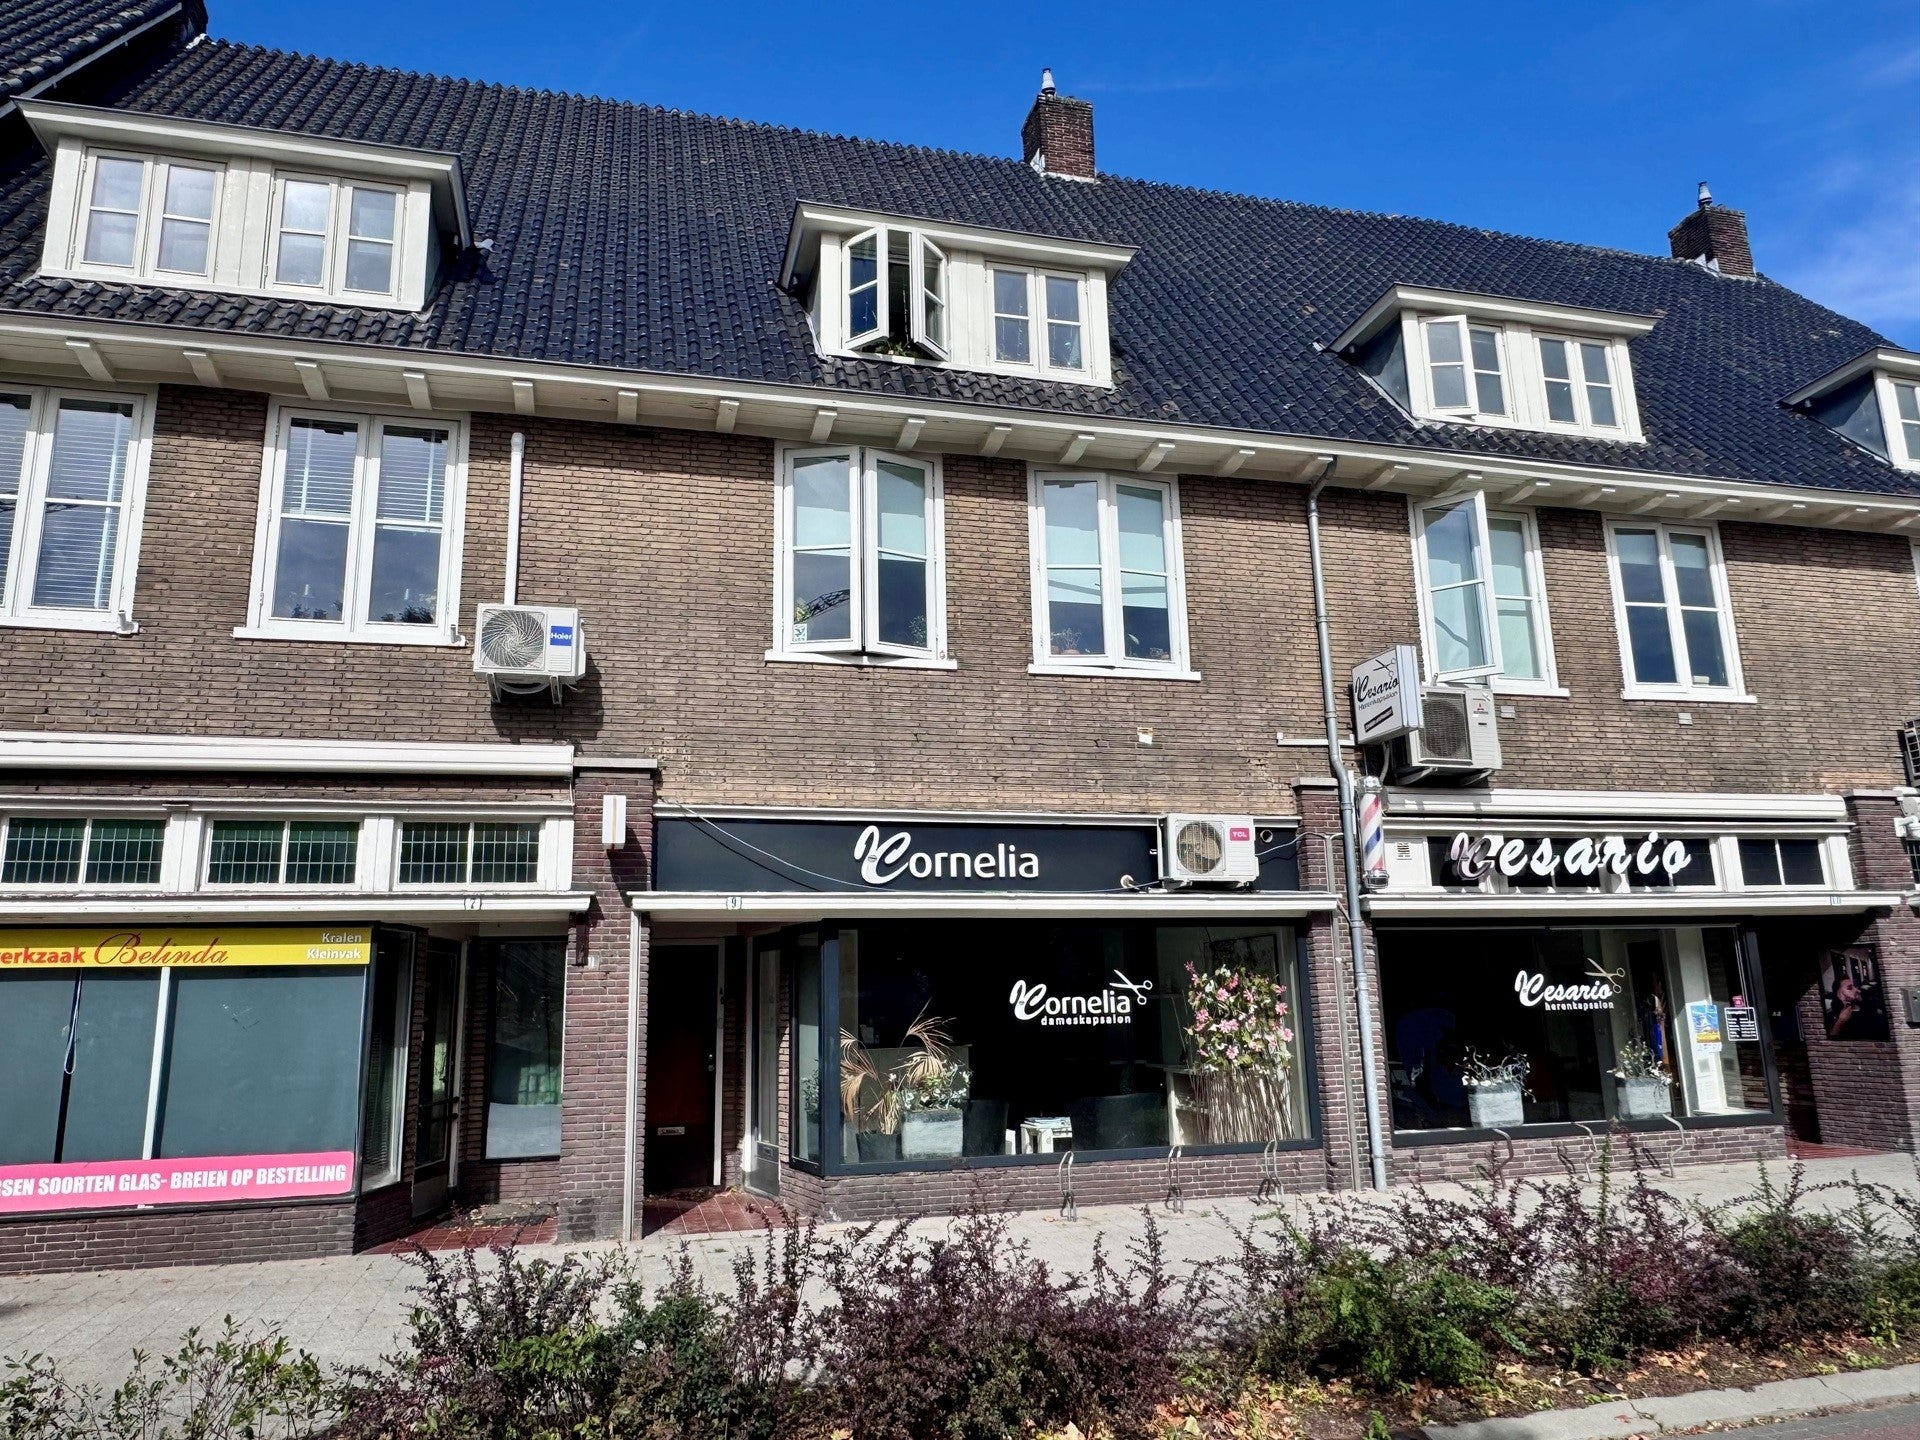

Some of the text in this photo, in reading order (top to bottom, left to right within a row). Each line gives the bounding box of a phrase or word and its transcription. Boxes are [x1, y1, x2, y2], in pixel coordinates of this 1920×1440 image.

[551, 632, 572, 640] Haier
[1354, 675, 1399, 702] Cesario
[854, 825, 1039, 885] Cornelia
[1451, 831, 1691, 880] Cesario
[0, 932, 228, 965] erkzaak Belinda
[322, 932, 362, 943] Kralen
[307, 948, 361, 959] Kleinvak
[1009, 979, 1131, 1021] Cornelia
[1514, 970, 1613, 1007] Cesario
[1040, 1015, 1131, 1026] dameskapsalon
[1545, 1001, 1614, 1011] herenkapsalon
[0, 1178, 35, 1197] SEN
[38, 1174, 116, 1196] SOORTEN
[170, 1169, 228, 1190] BREIEN
[231, 1168, 254, 1187] OP
[256, 1164, 347, 1185] BESTELLING
